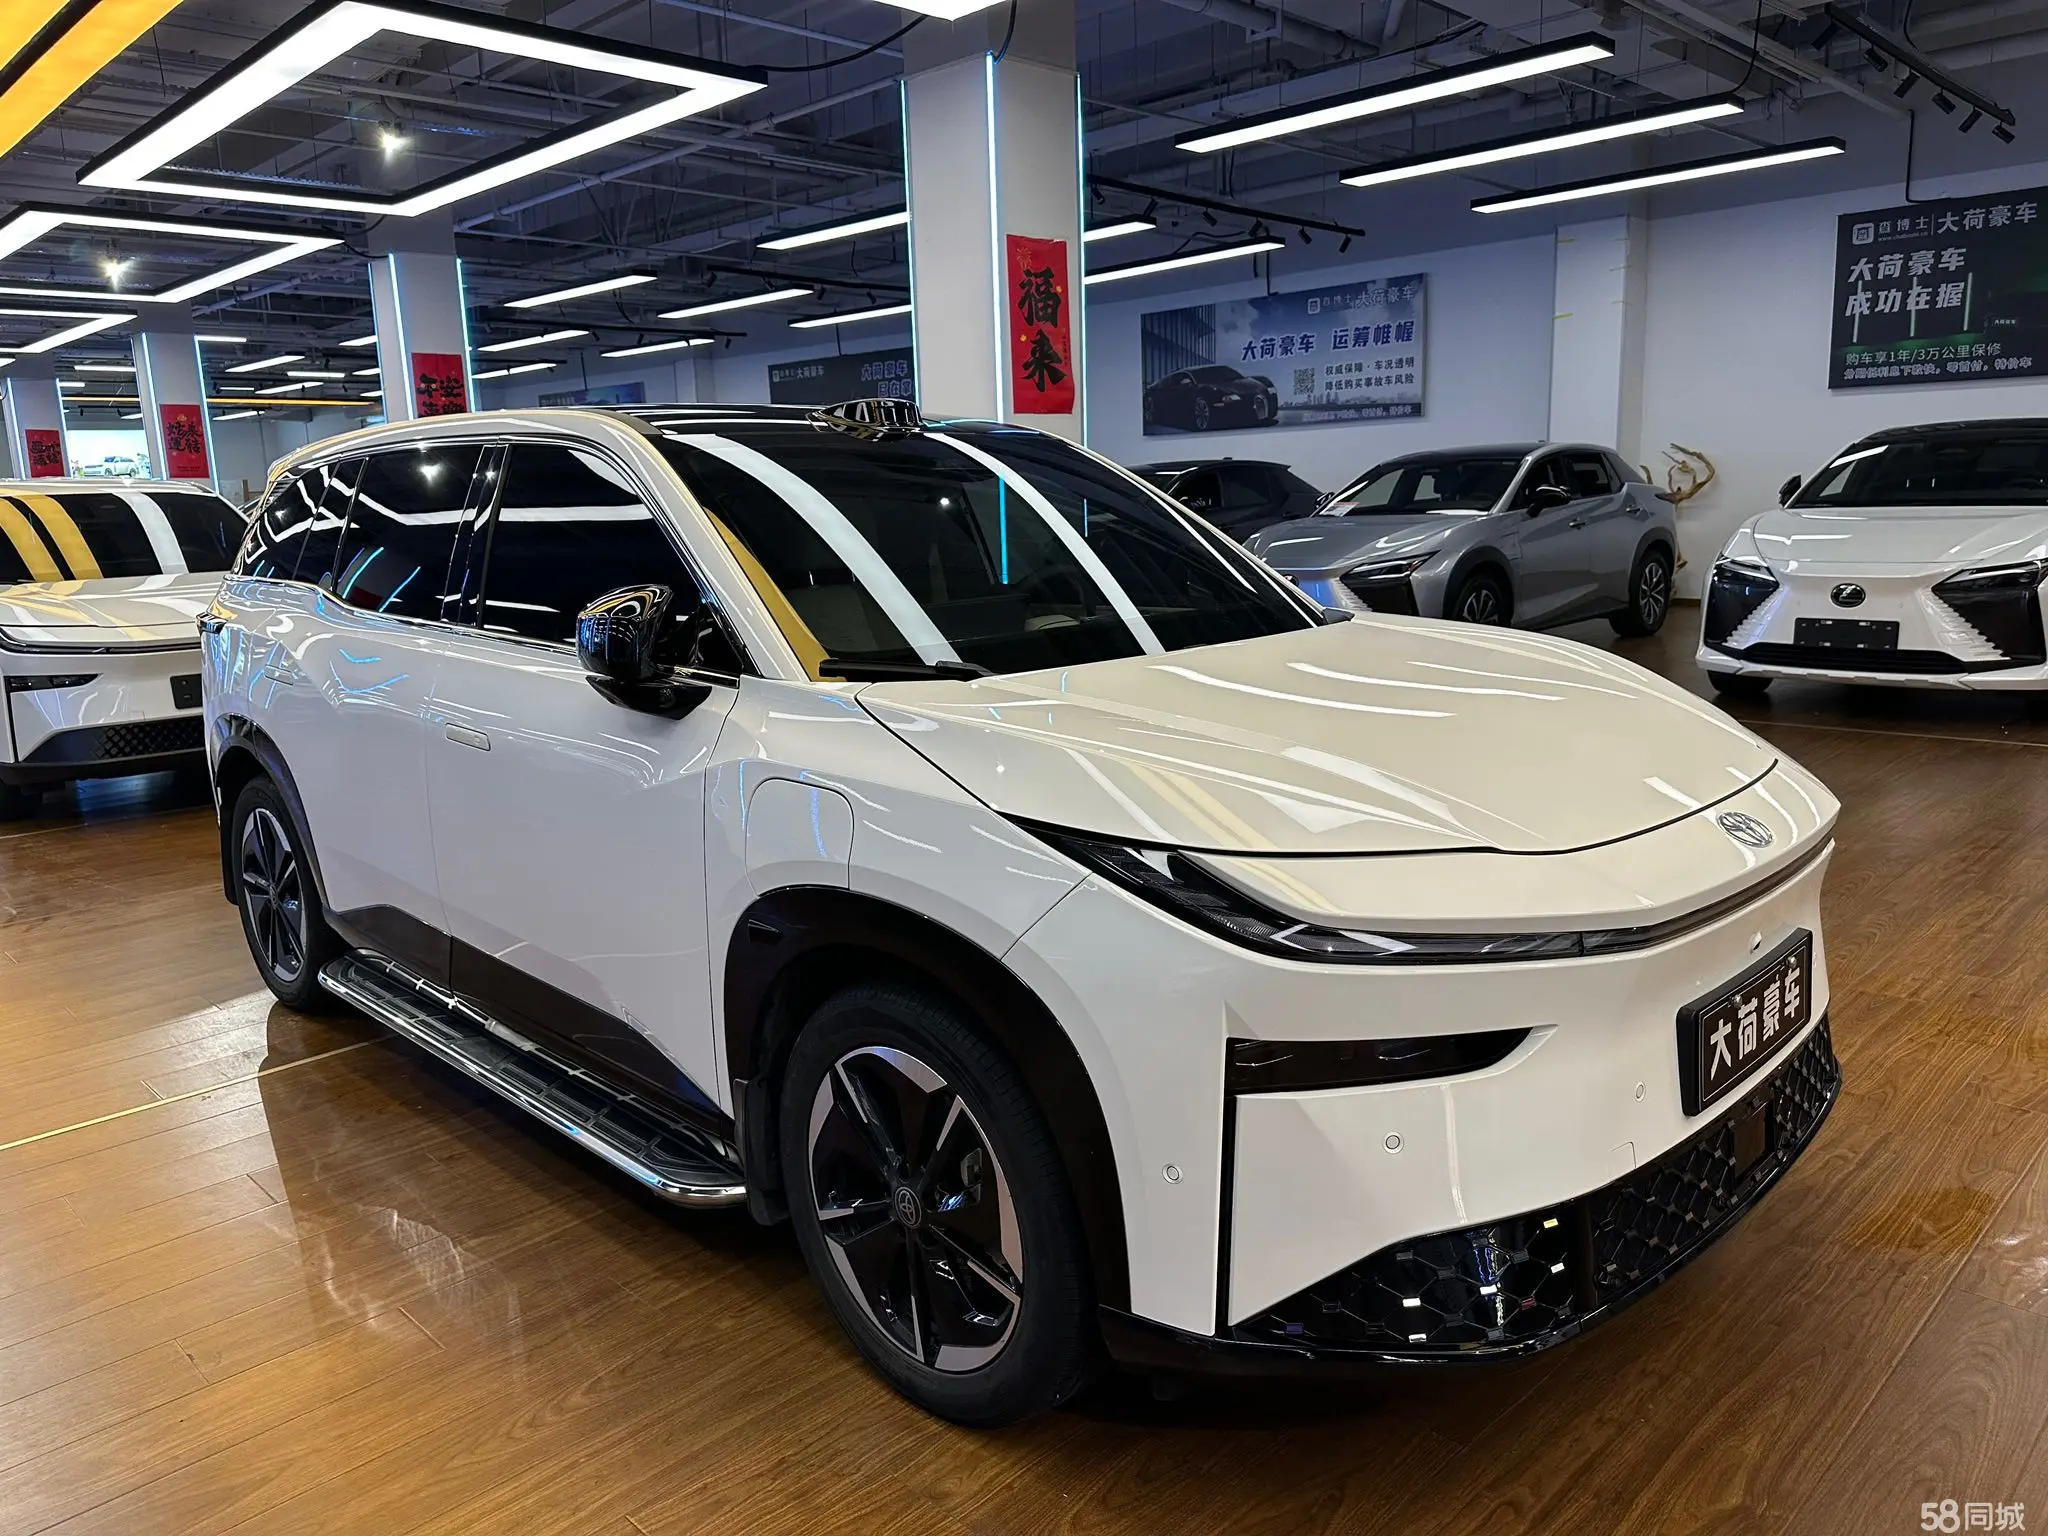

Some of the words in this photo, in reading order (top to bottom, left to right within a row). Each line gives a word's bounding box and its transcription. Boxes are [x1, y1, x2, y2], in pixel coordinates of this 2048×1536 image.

[1937, 202, 2038, 234] 大荷豪车
[1848, 248, 1967, 282] 大荷豪车
[1845, 282, 1965, 316] 成功在握
[1241, 333, 1315, 362] 大荷豪车
[1331, 320, 1415, 350] 运筹帷幄
[1846, 342, 2001, 366] 购车享1年/3万公里保修
[1325, 373, 1414, 391] 降低购买事故车风险
[1710, 967, 1800, 1081] 大荷豪车
